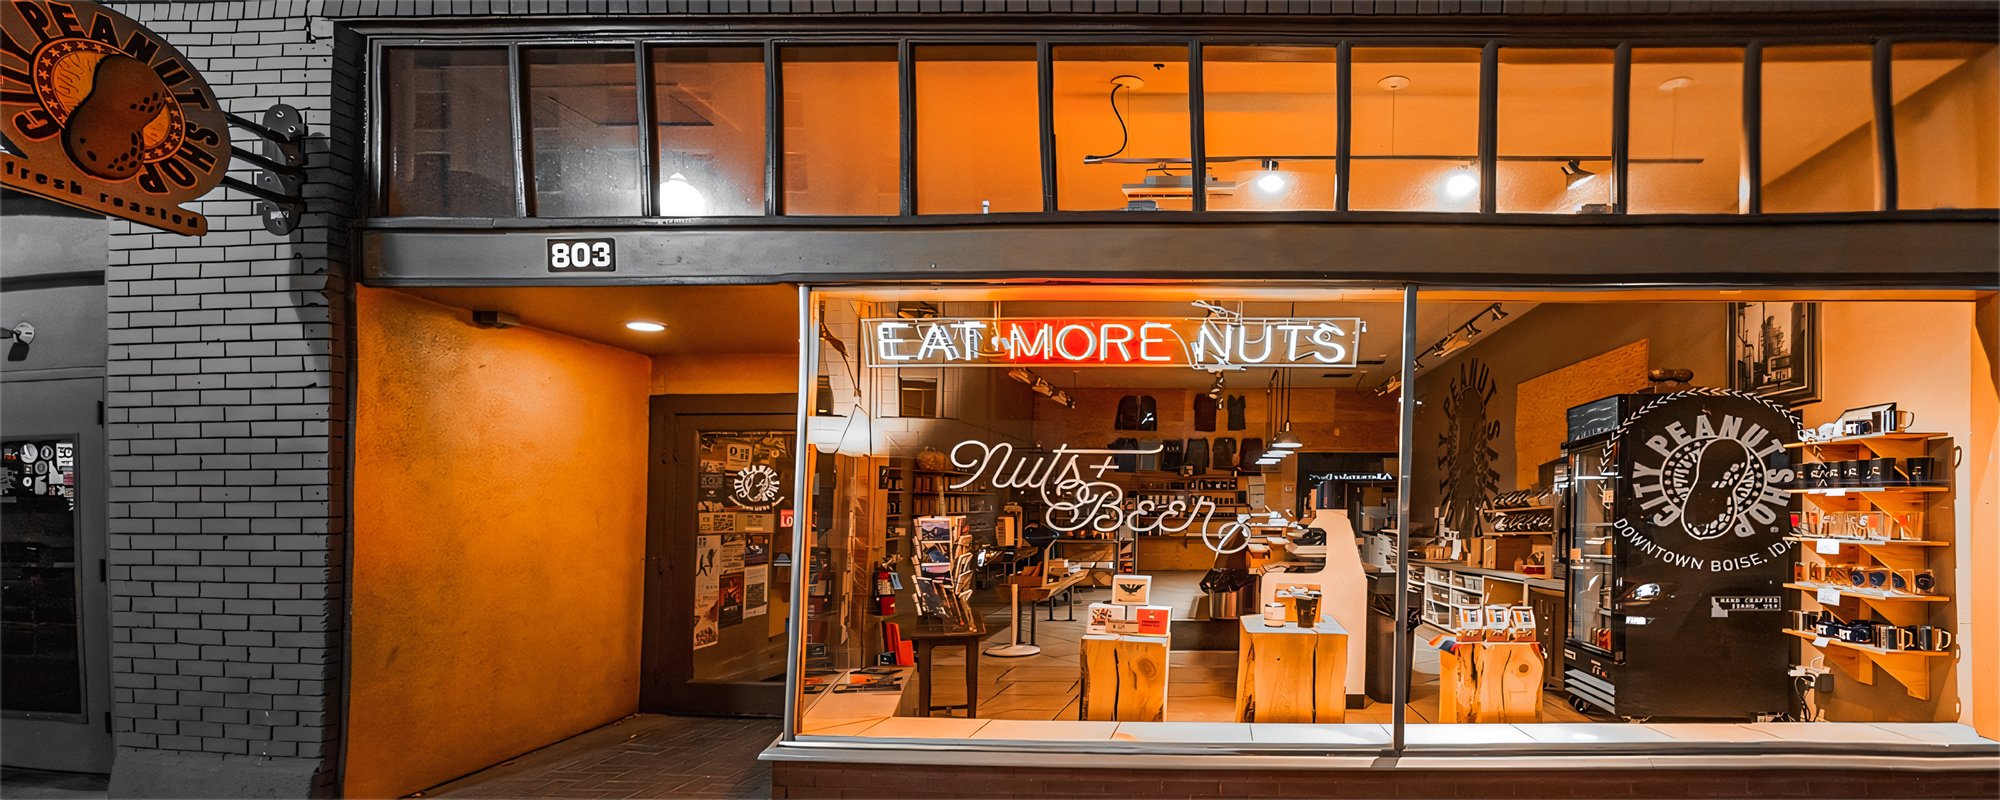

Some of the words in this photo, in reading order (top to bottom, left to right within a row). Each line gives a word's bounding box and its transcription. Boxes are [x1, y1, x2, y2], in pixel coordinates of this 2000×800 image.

[12, 0, 210, 110] PEANUT
[136, 120, 220, 194] SHOP
[5, 161, 82, 195] fresh
[100, 192, 198, 228] roasted
[551, 242, 611, 268] 803
[877, 322, 987, 361] EAT
[1009, 323, 1172, 362] MORE
[1197, 322, 1346, 363] NUTS
[1645, 414, 1786, 459] PEANUT
[950, 440, 1164, 506] Nuts
[1632, 461, 1683, 527] CITY
[1733, 468, 1796, 538] SHOP
[1613, 517, 1704, 570] DOWNTOWN
[1710, 552, 1768, 572] BOISE,
